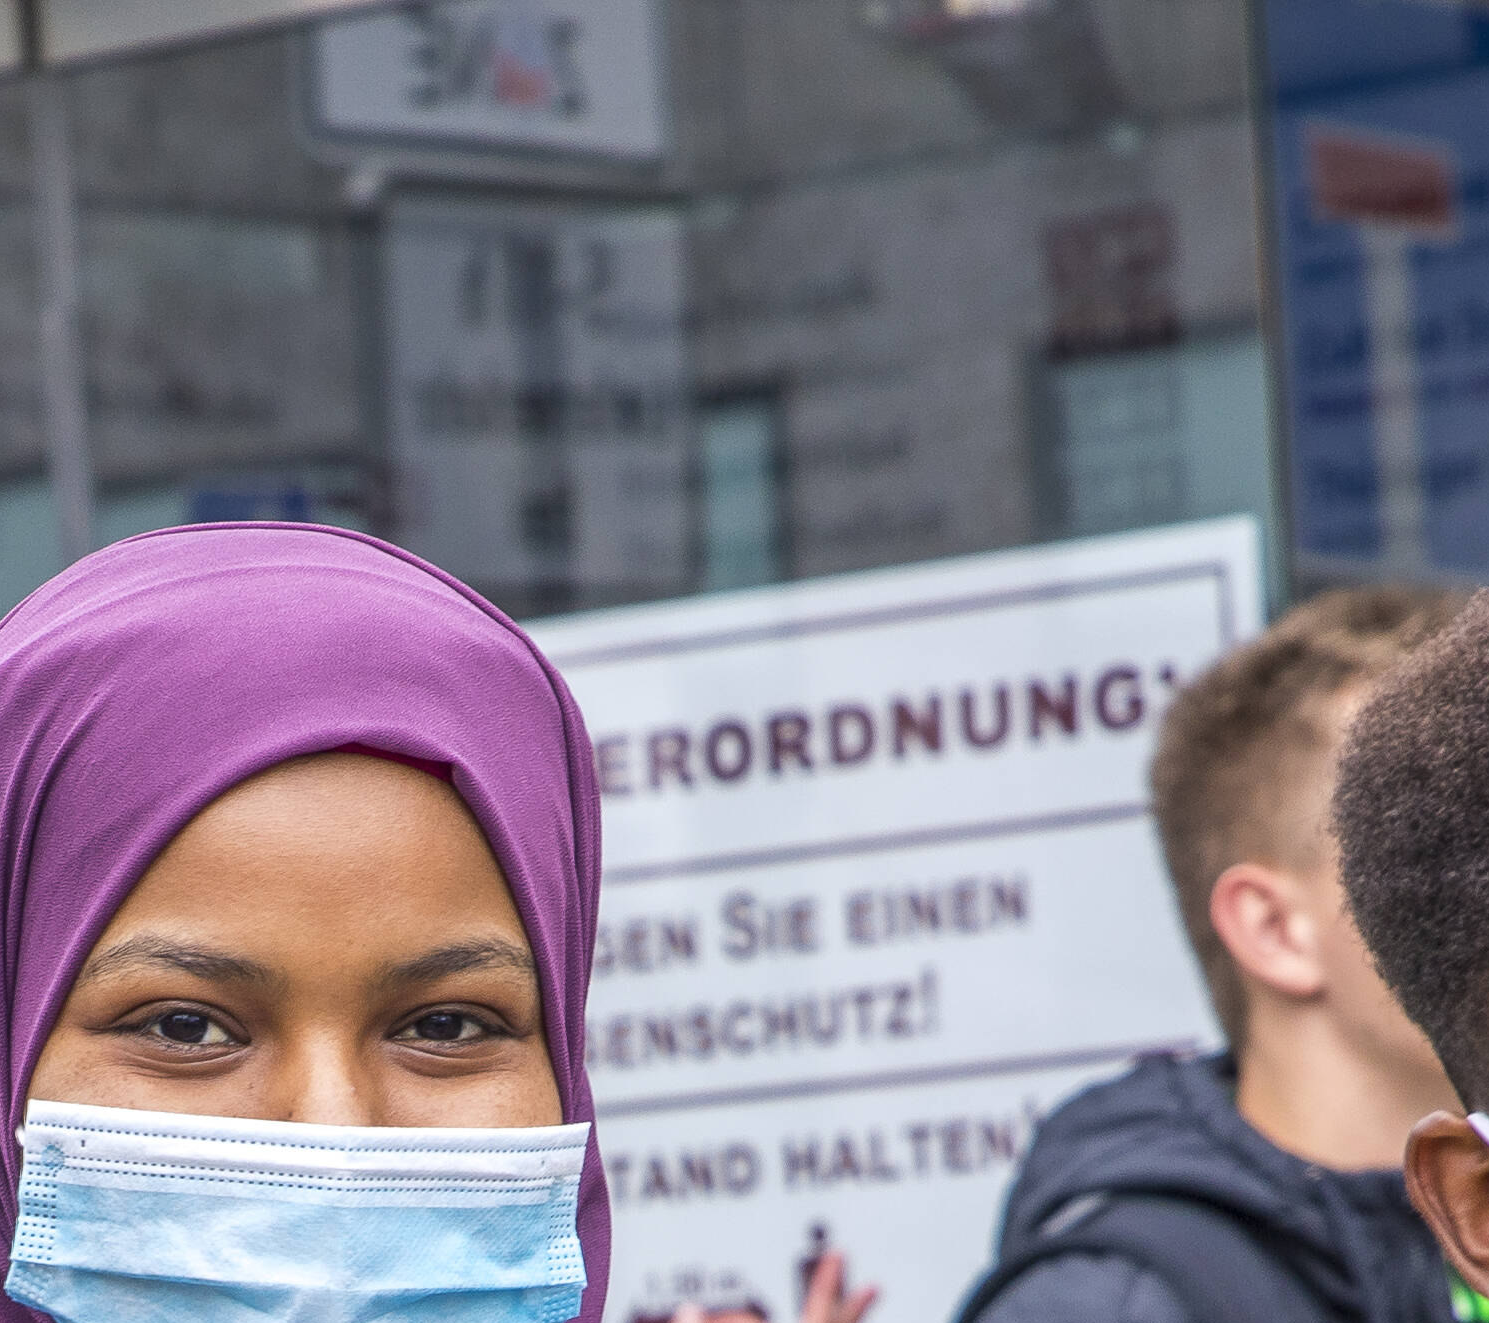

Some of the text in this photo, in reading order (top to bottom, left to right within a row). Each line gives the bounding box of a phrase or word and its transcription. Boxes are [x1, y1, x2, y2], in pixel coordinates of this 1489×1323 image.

[598, 662, 1175, 798] ERORDNUNG:
[586, 967, 939, 1070] ENSCHUTZ!
[608, 1138, 763, 1205] TAND
